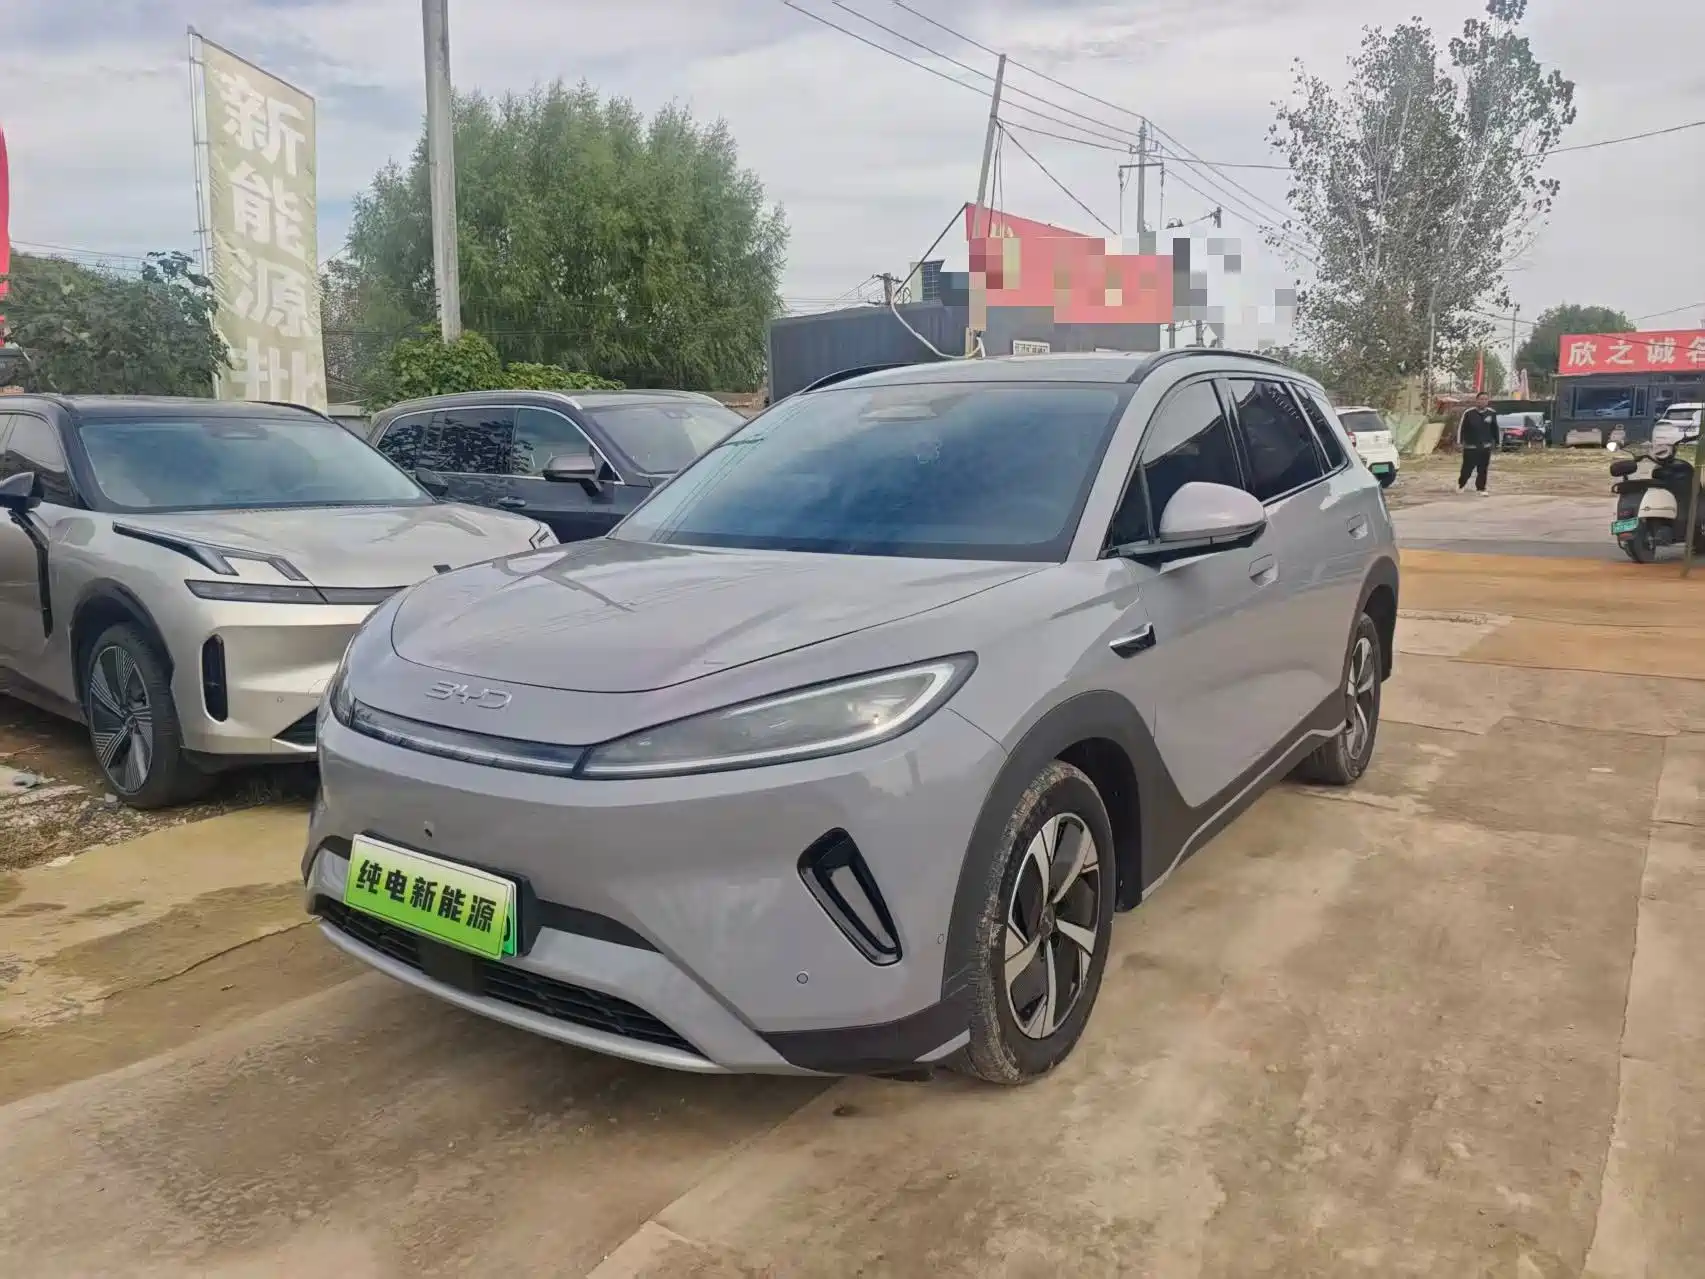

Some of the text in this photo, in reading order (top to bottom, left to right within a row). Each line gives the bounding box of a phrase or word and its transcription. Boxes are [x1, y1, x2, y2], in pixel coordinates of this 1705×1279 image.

[424, 680, 513, 710] BYD
[355, 859, 497, 933] 纯电新能源
